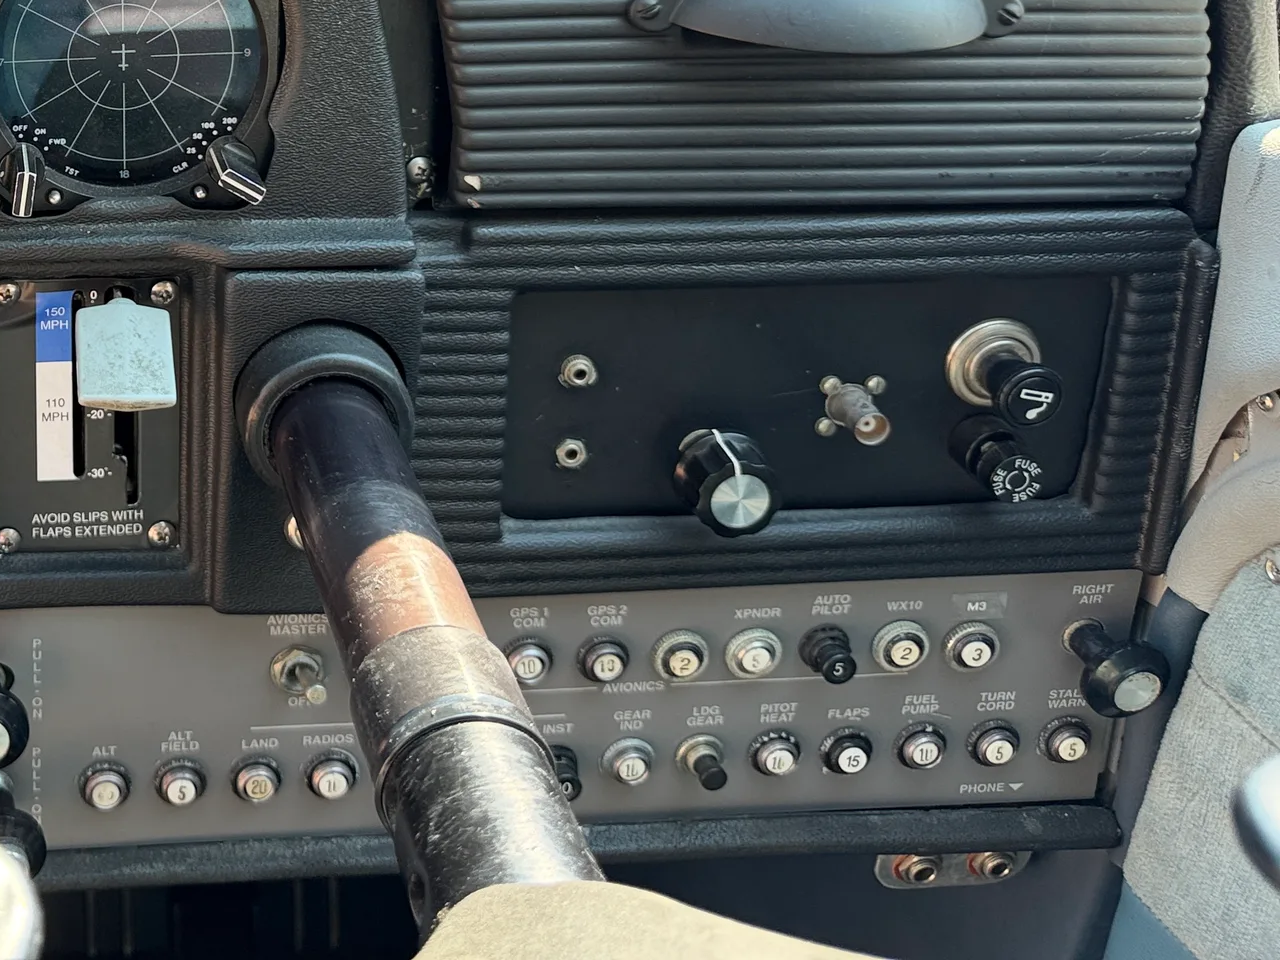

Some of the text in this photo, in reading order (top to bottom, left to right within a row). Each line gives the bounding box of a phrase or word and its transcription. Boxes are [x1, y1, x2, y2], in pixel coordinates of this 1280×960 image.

[45, 307, 65, 317] 150
[40, 320, 68, 330] MPH
[1015, 459, 1041, 477] FUSE
[32, 510, 143, 524] AVOID SLIPS WITH
[32, 524, 142, 537] FLAPS EXTENDED
[1073, 585, 1114, 595] RIGHT
[887, 601, 923, 611] WX10
[734, 608, 781, 619] XPNDR
[270, 625, 325, 635] MASTER
[603, 681, 664, 694] AVIONICS
[980, 692, 1016, 702] TURN
[760, 703, 797, 713] PITOT
[828, 707, 869, 718] FLAPS
[760, 713, 795, 723] HEAT
[303, 734, 354, 745] RADIOS
[162, 741, 199, 751] FIELD
[960, 782, 1004, 793] PHONE
